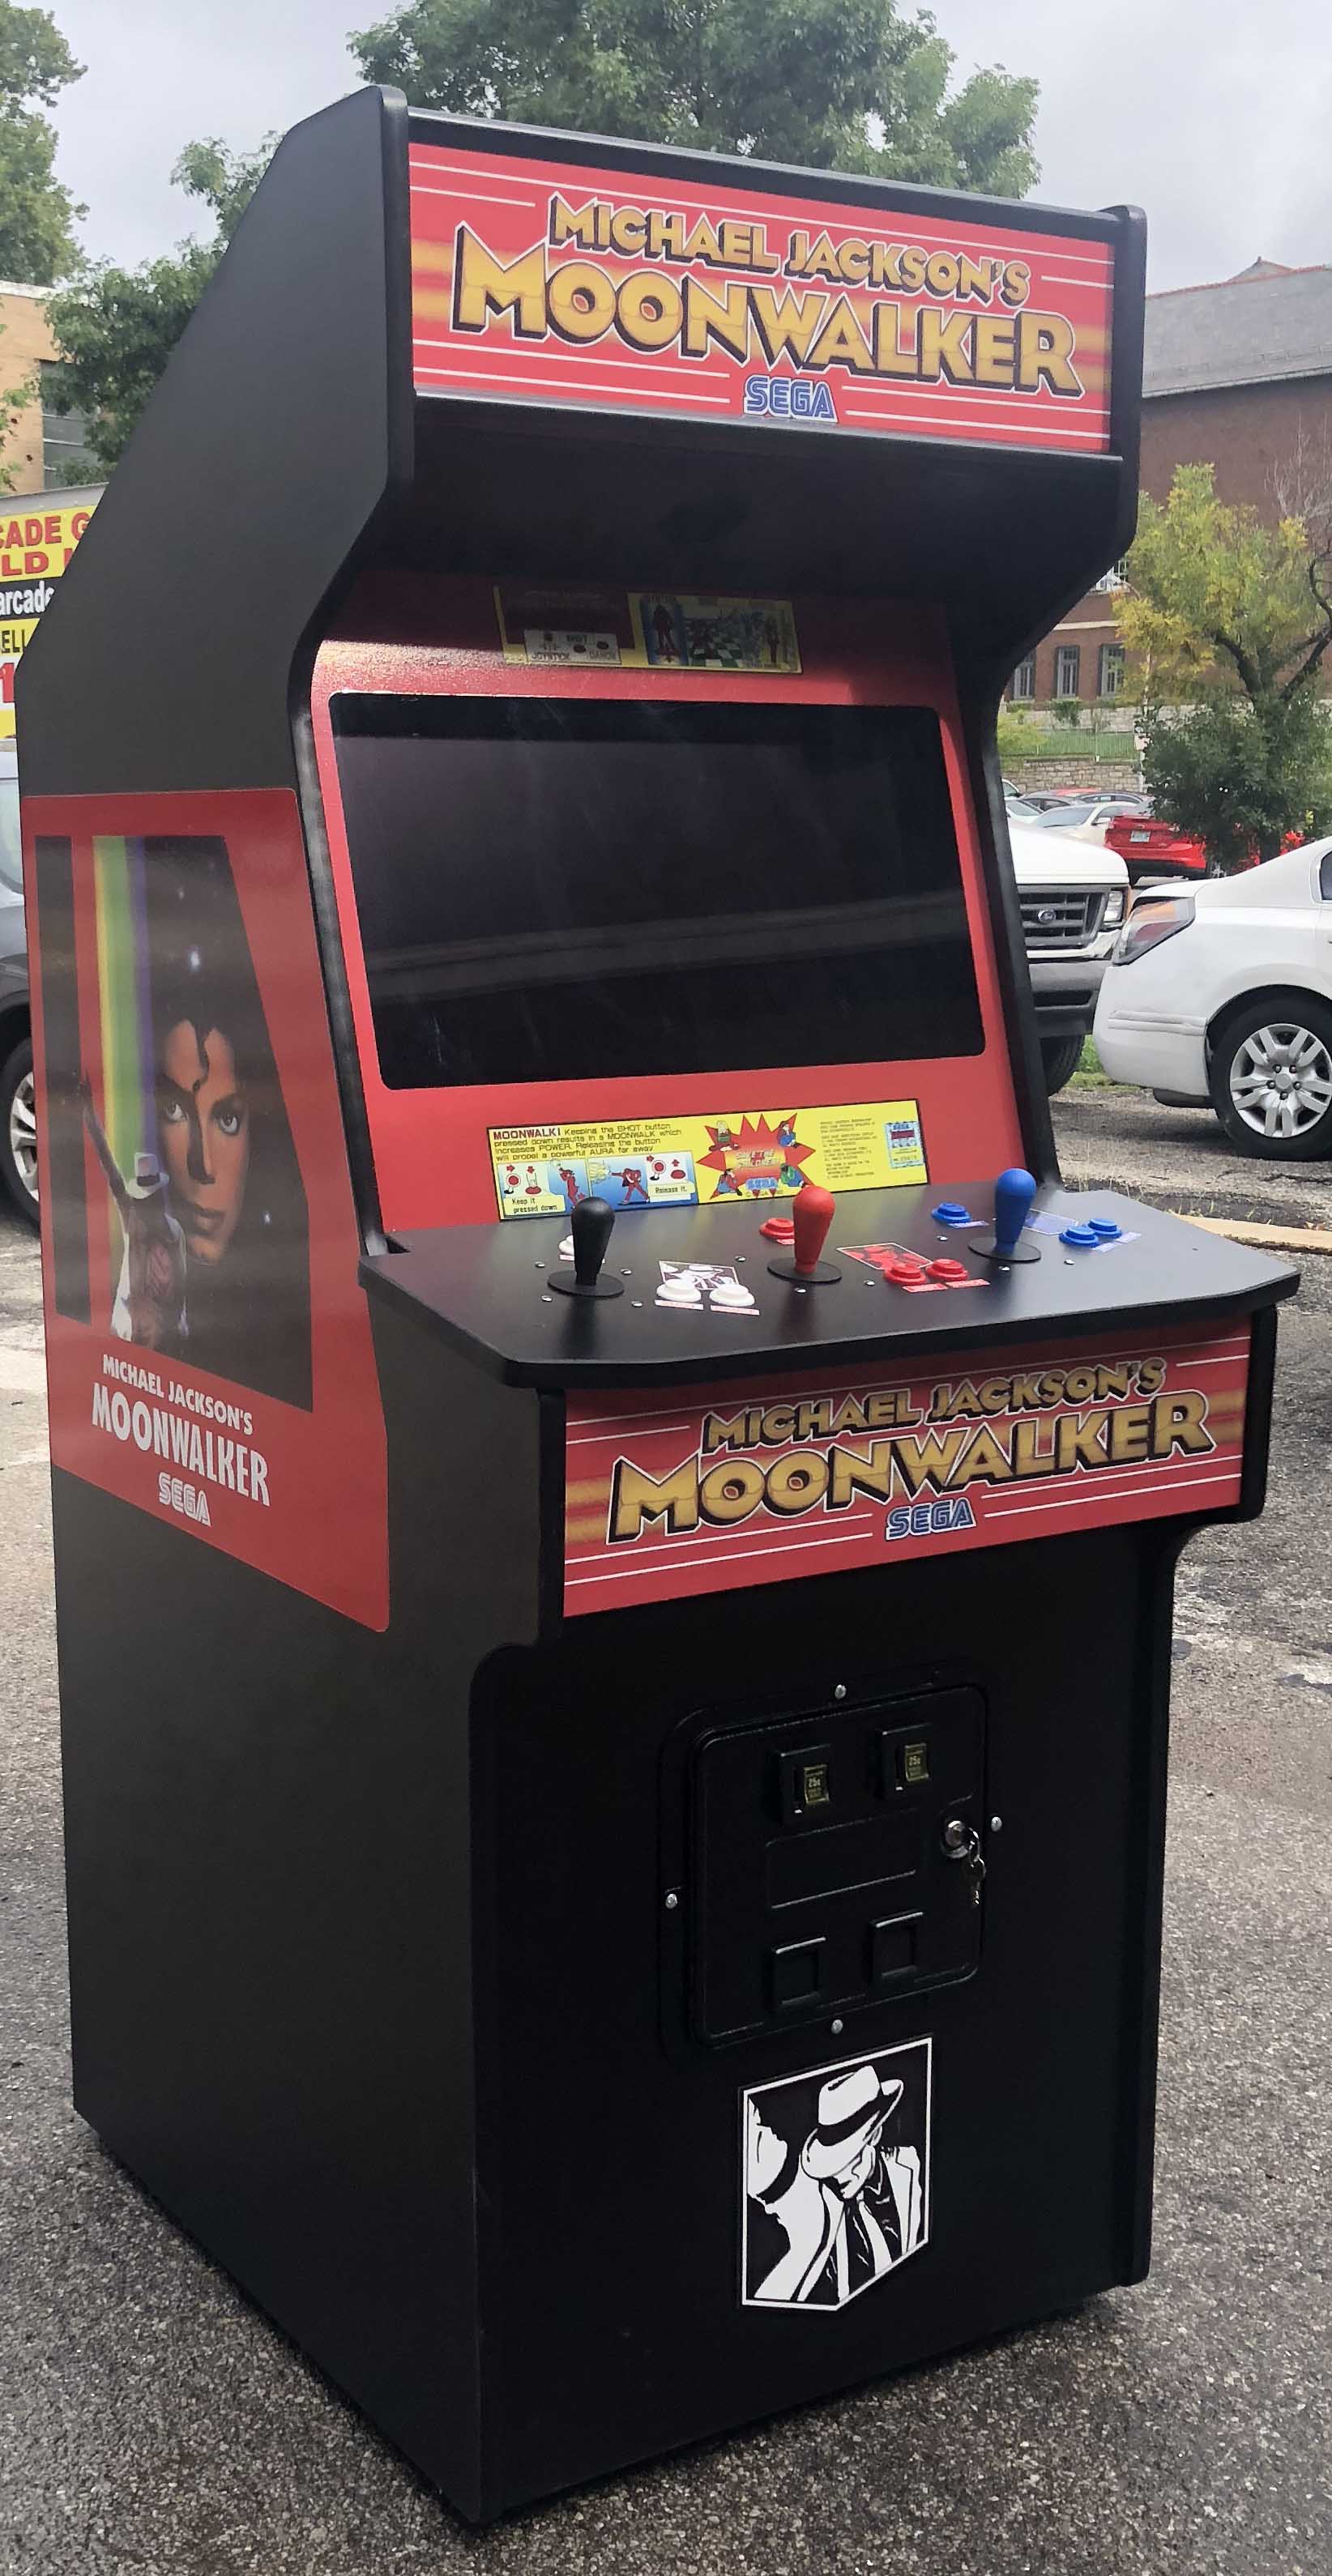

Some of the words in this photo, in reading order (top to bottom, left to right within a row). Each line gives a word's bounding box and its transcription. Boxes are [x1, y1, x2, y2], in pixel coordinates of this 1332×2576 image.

[549, 193, 779, 274] MICHAEL
[786, 232, 1031, 308] JACKSON'S
[451, 222, 1085, 399] MOONWALKER
[744, 376, 839, 423] SEGA
[0, 515, 62, 549] ADE
[494, 1138, 527, 1147] pressed
[103, 1354, 164, 1398] MICHAEL
[168, 1380, 254, 1435] JACKSON'S
[702, 1388, 923, 1452] MICHAEL
[928, 1358, 1167, 1422] JACKSON'S
[92, 1383, 271, 1507] MOONWALKER
[608, 1390, 1216, 1544] MOONWALKER
[158, 1471, 211, 1526] SEGA
[886, 1497, 976, 1540] SEGA
